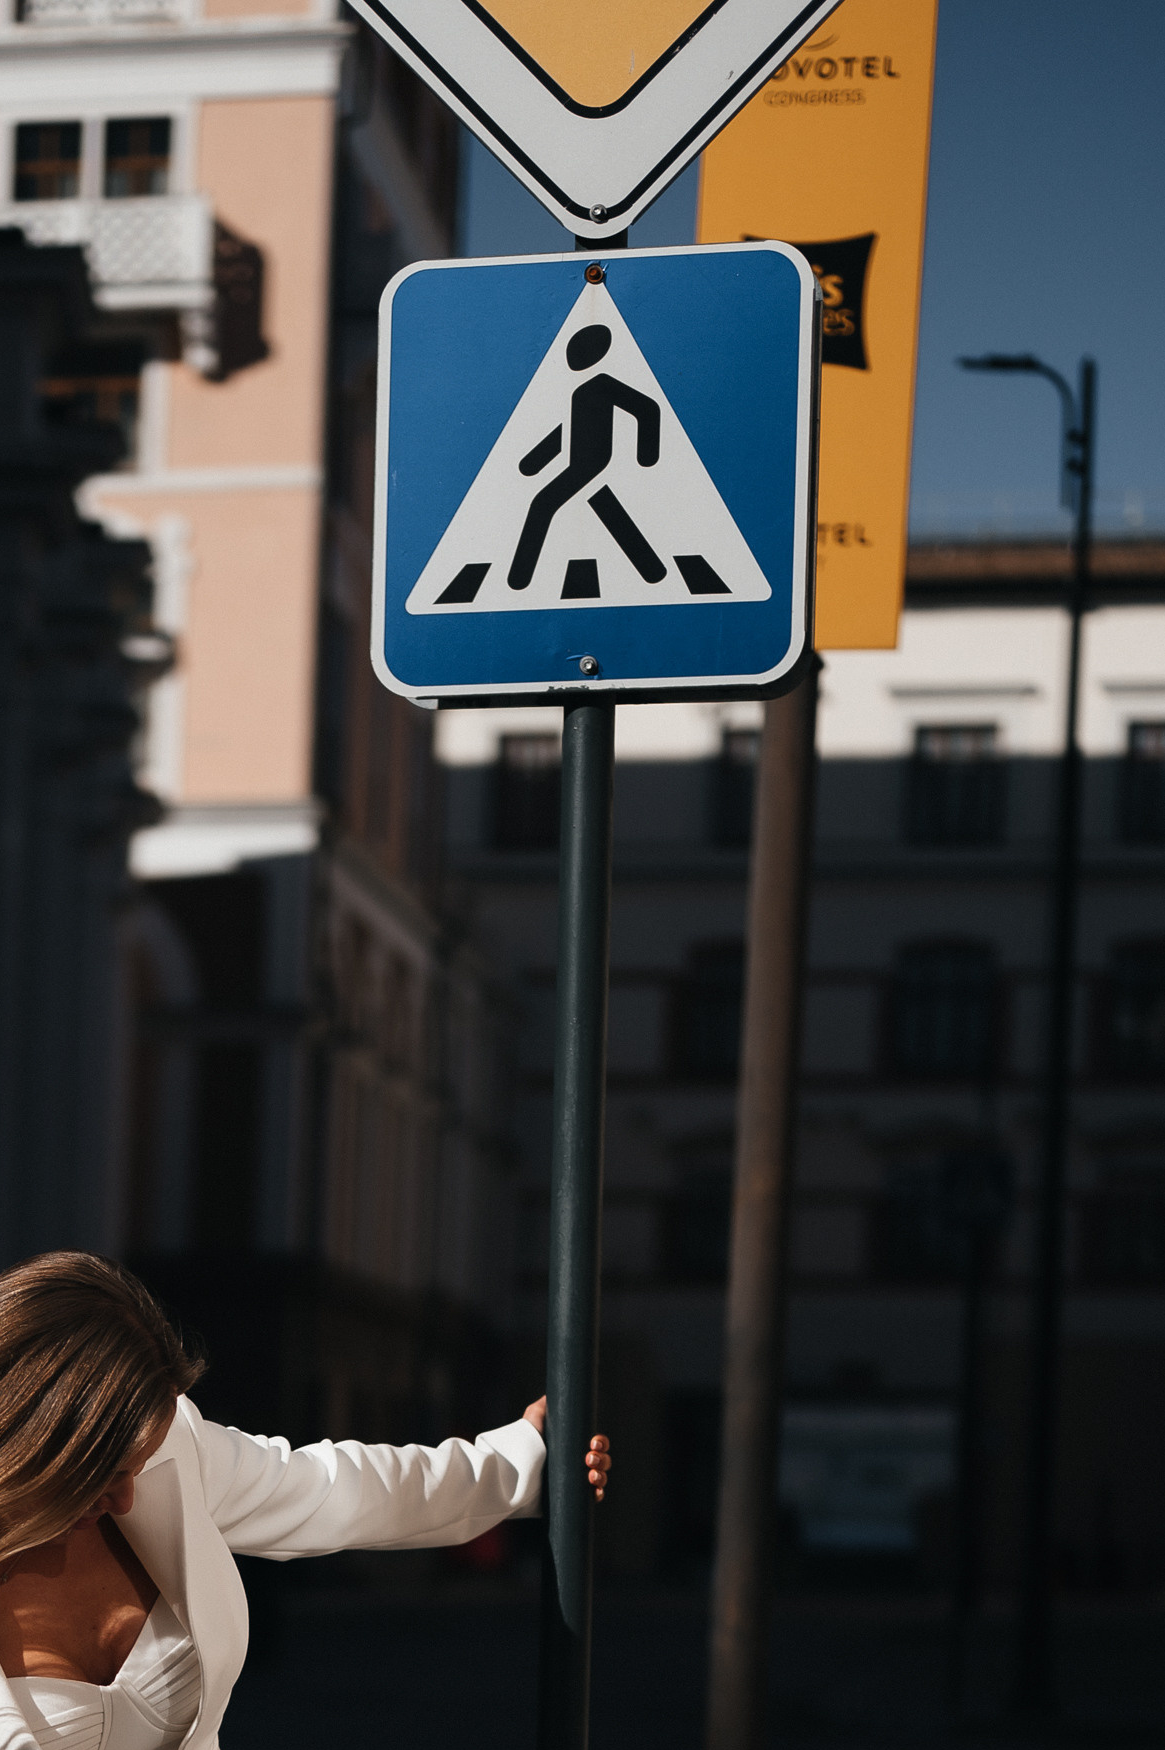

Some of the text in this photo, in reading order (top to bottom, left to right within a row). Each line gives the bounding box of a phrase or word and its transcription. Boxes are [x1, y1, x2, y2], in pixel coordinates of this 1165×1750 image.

[770, 56, 900, 81] OVOTEL
[764, 89, 866, 107] CONGRESS
[817, 522, 872, 548] TEL
